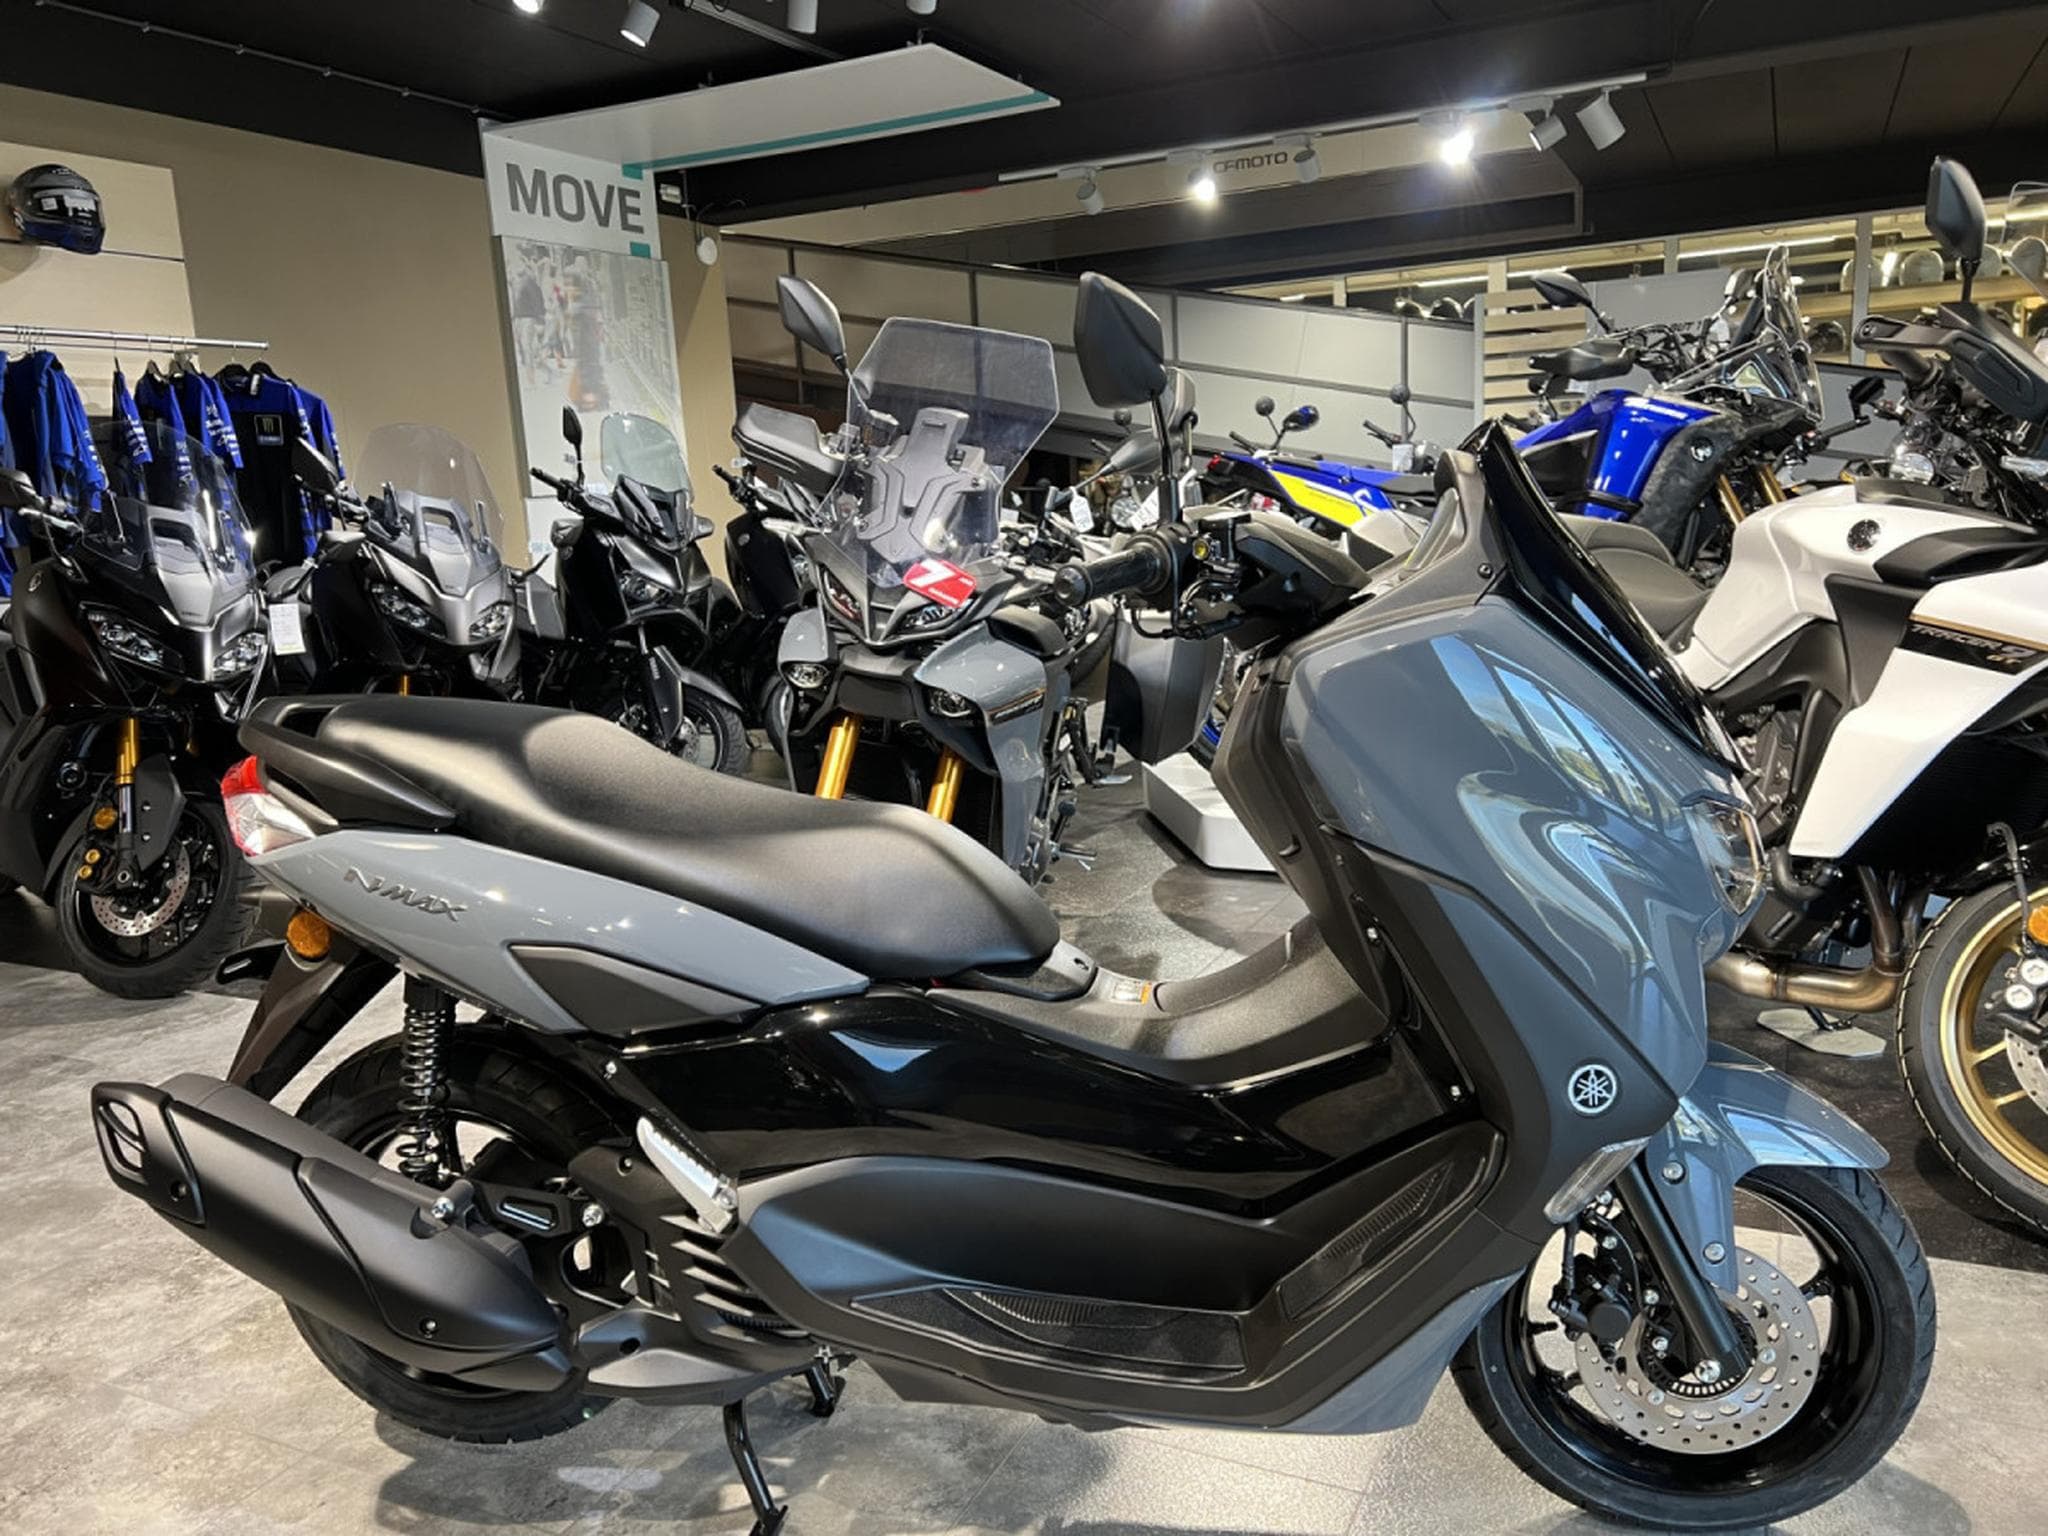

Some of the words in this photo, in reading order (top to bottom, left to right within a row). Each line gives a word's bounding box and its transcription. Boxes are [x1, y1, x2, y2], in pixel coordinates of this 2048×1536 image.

[1213, 151, 1288, 174] CFMOTO
[506, 162, 645, 234] MOVE
[343, 865, 468, 922] NMAX
